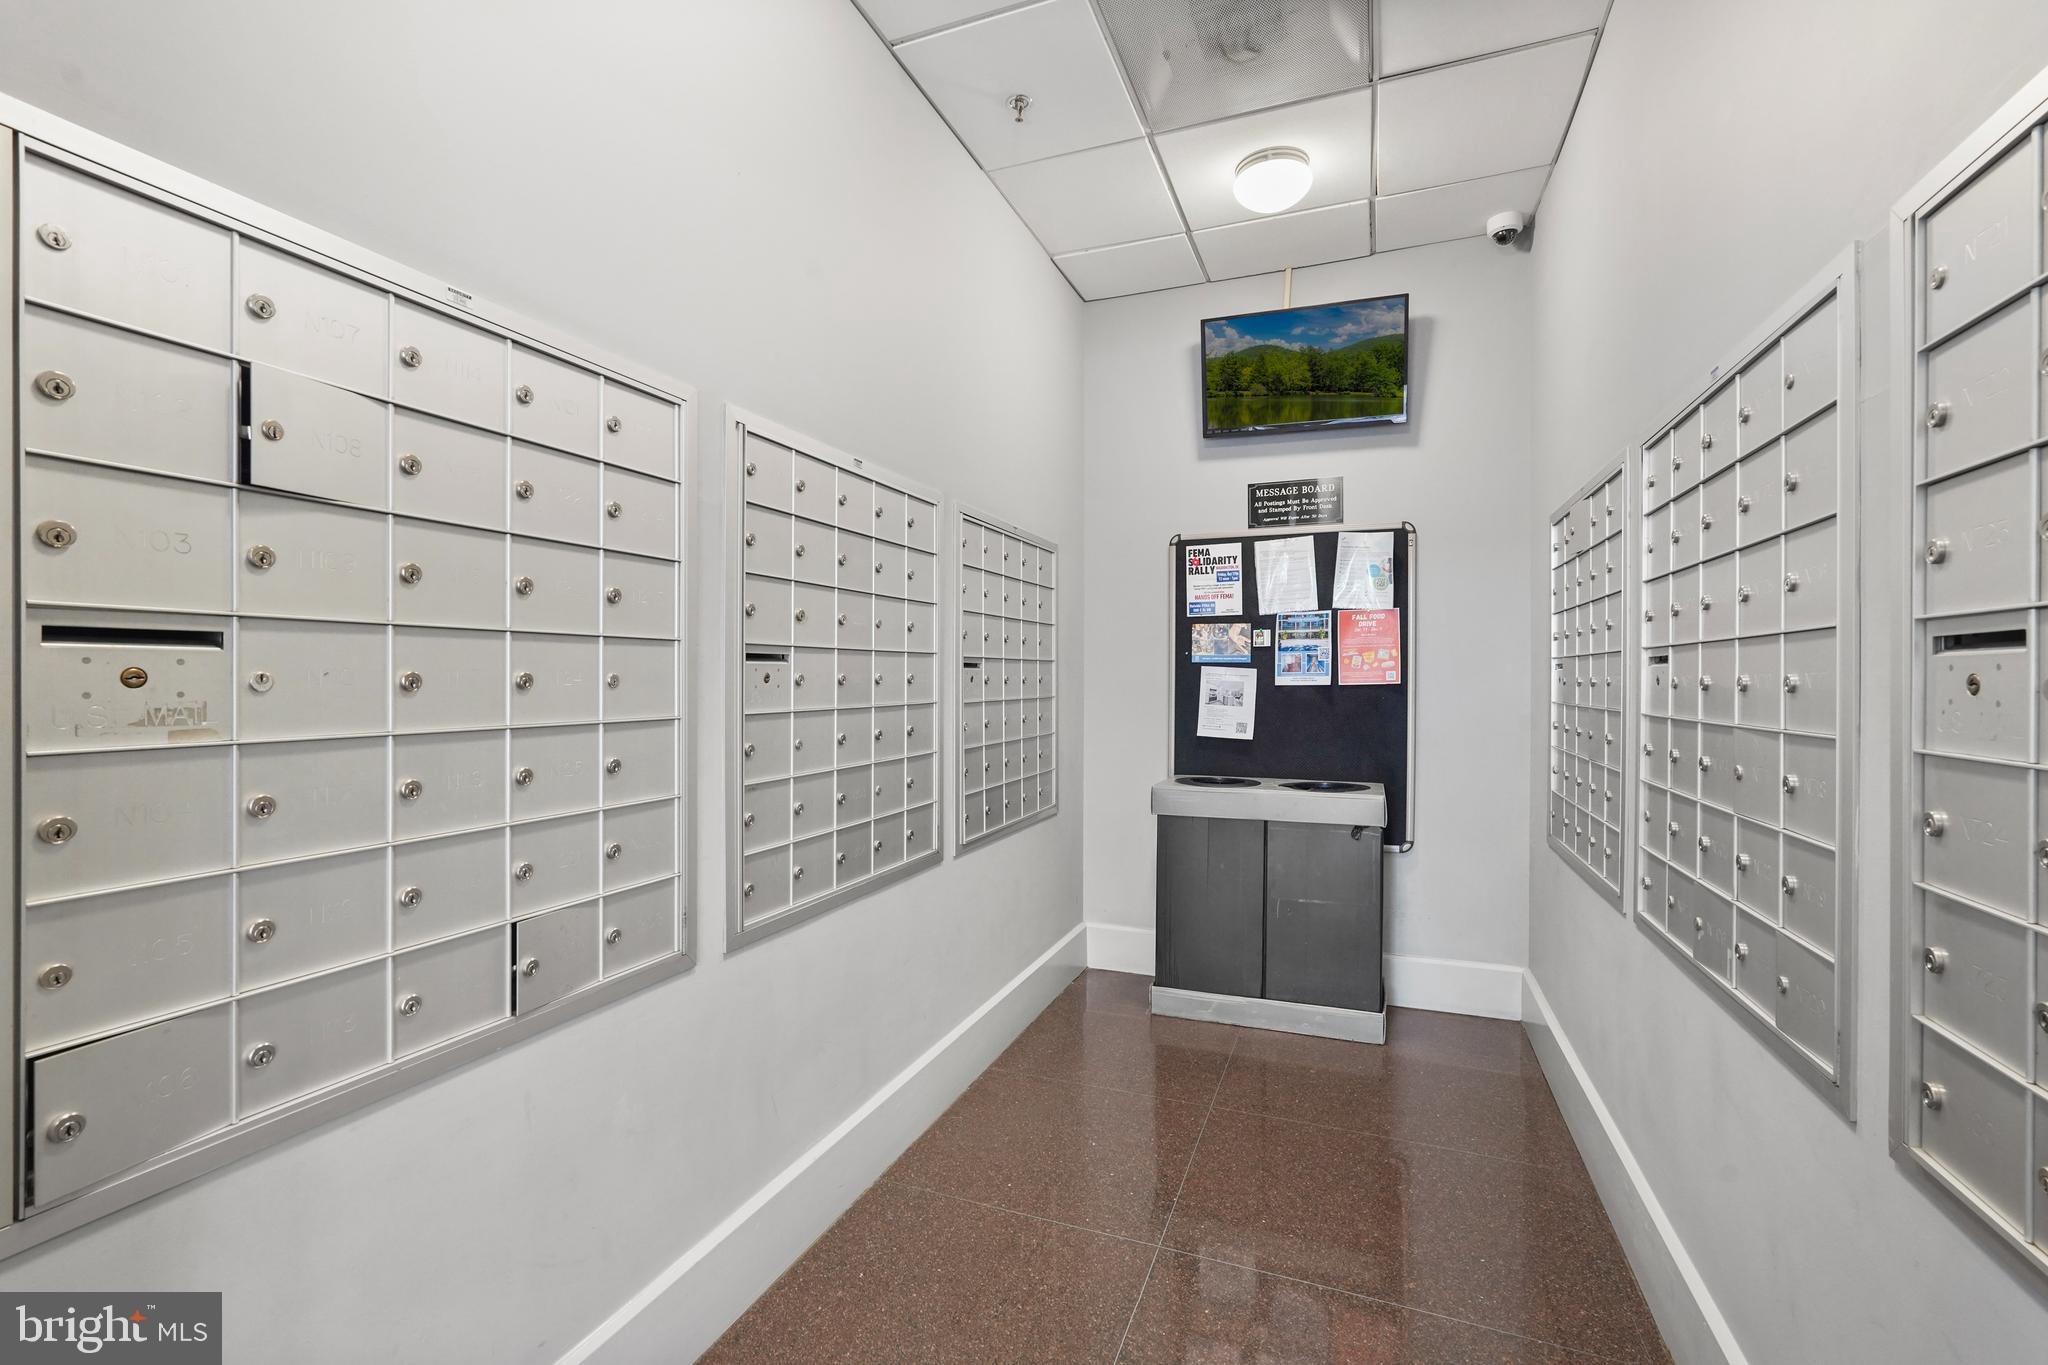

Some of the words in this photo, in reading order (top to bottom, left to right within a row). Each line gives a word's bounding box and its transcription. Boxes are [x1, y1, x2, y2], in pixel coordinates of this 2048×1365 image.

[1256, 486, 1299, 497] MESSAGE
[1302, 483, 1335, 494] BOARD
[1311, 496, 1337, 504] Approved
[113, 524, 193, 555] N103
[1188, 548, 1211, 557] FEMA
[1188, 555, 1238, 567] SOLIDARITY
[1188, 566, 1216, 576] RALLY
[144, 700, 219, 728] MAIL
